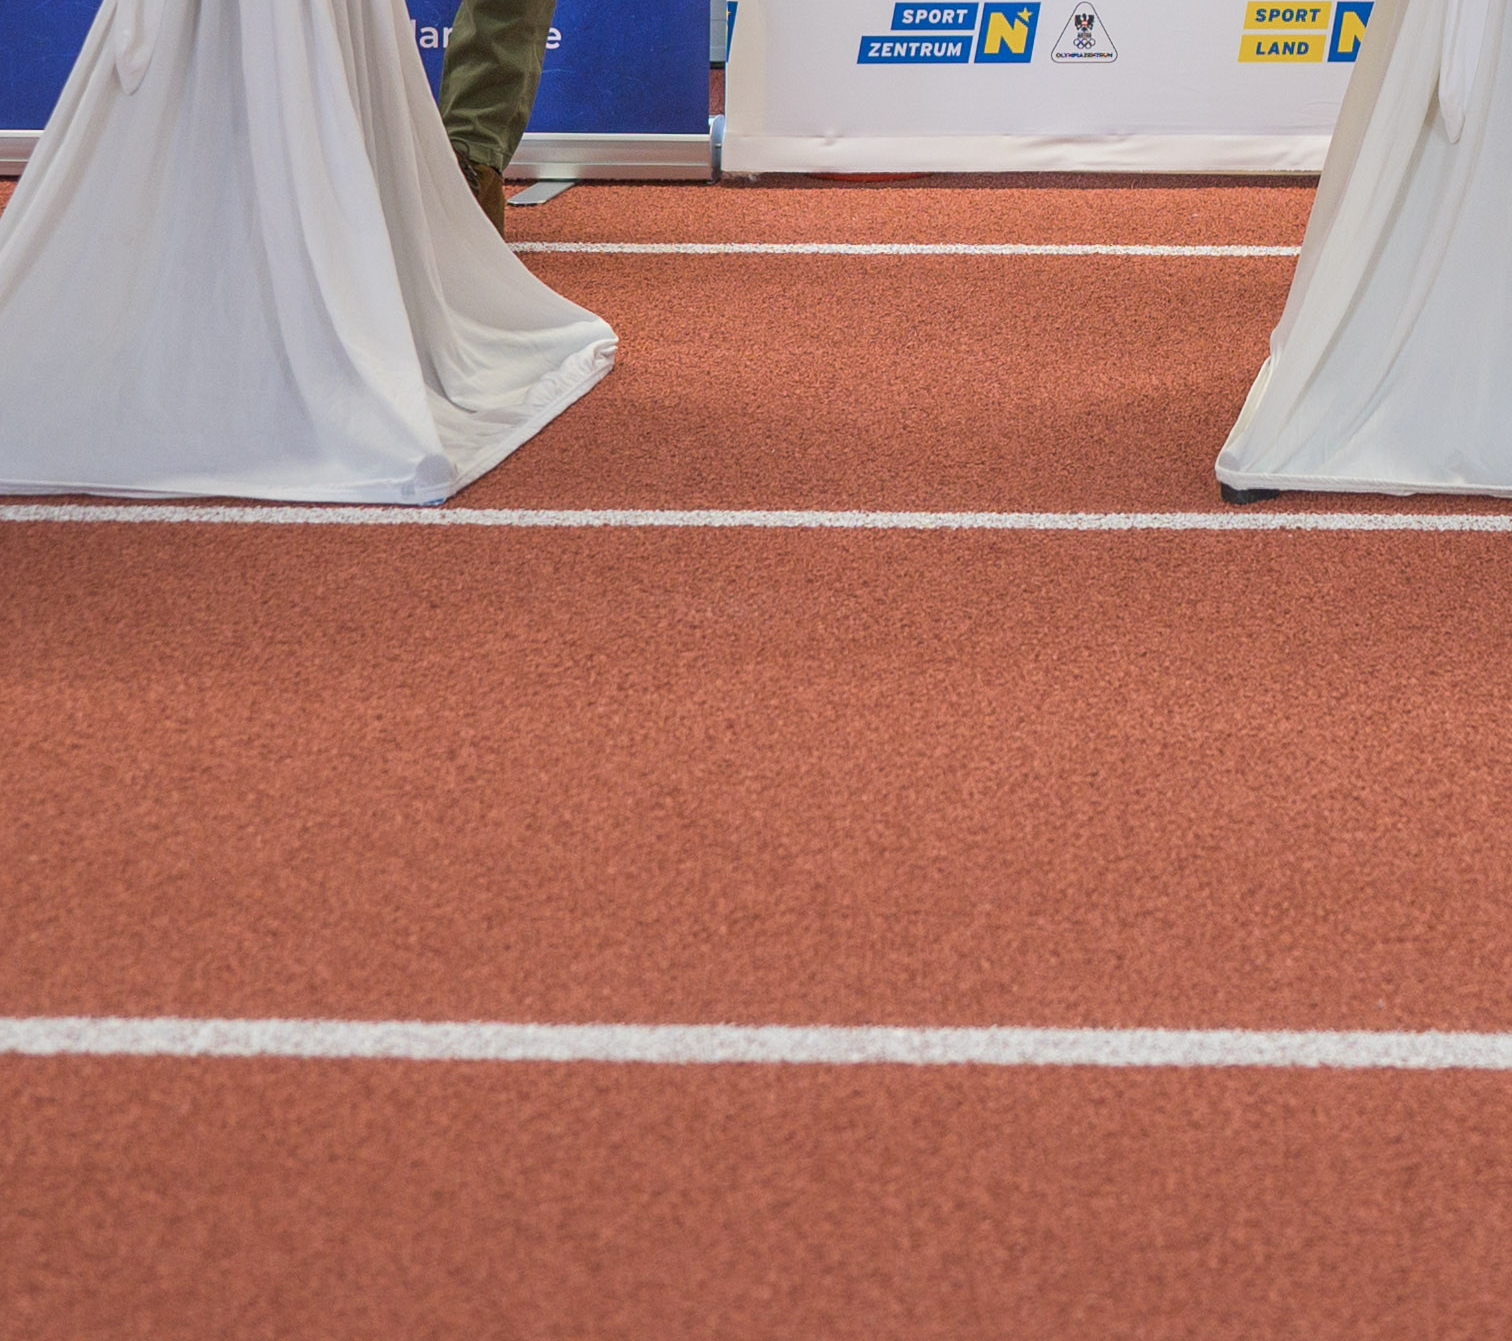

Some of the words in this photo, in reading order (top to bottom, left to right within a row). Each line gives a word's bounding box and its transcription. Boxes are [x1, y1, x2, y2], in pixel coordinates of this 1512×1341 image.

[901, 8, 969, 24] SPORT
[1255, 8, 1321, 23] SPORT
[868, 42, 963, 58] ZENTRUM
[1255, 41, 1310, 56] LAND
